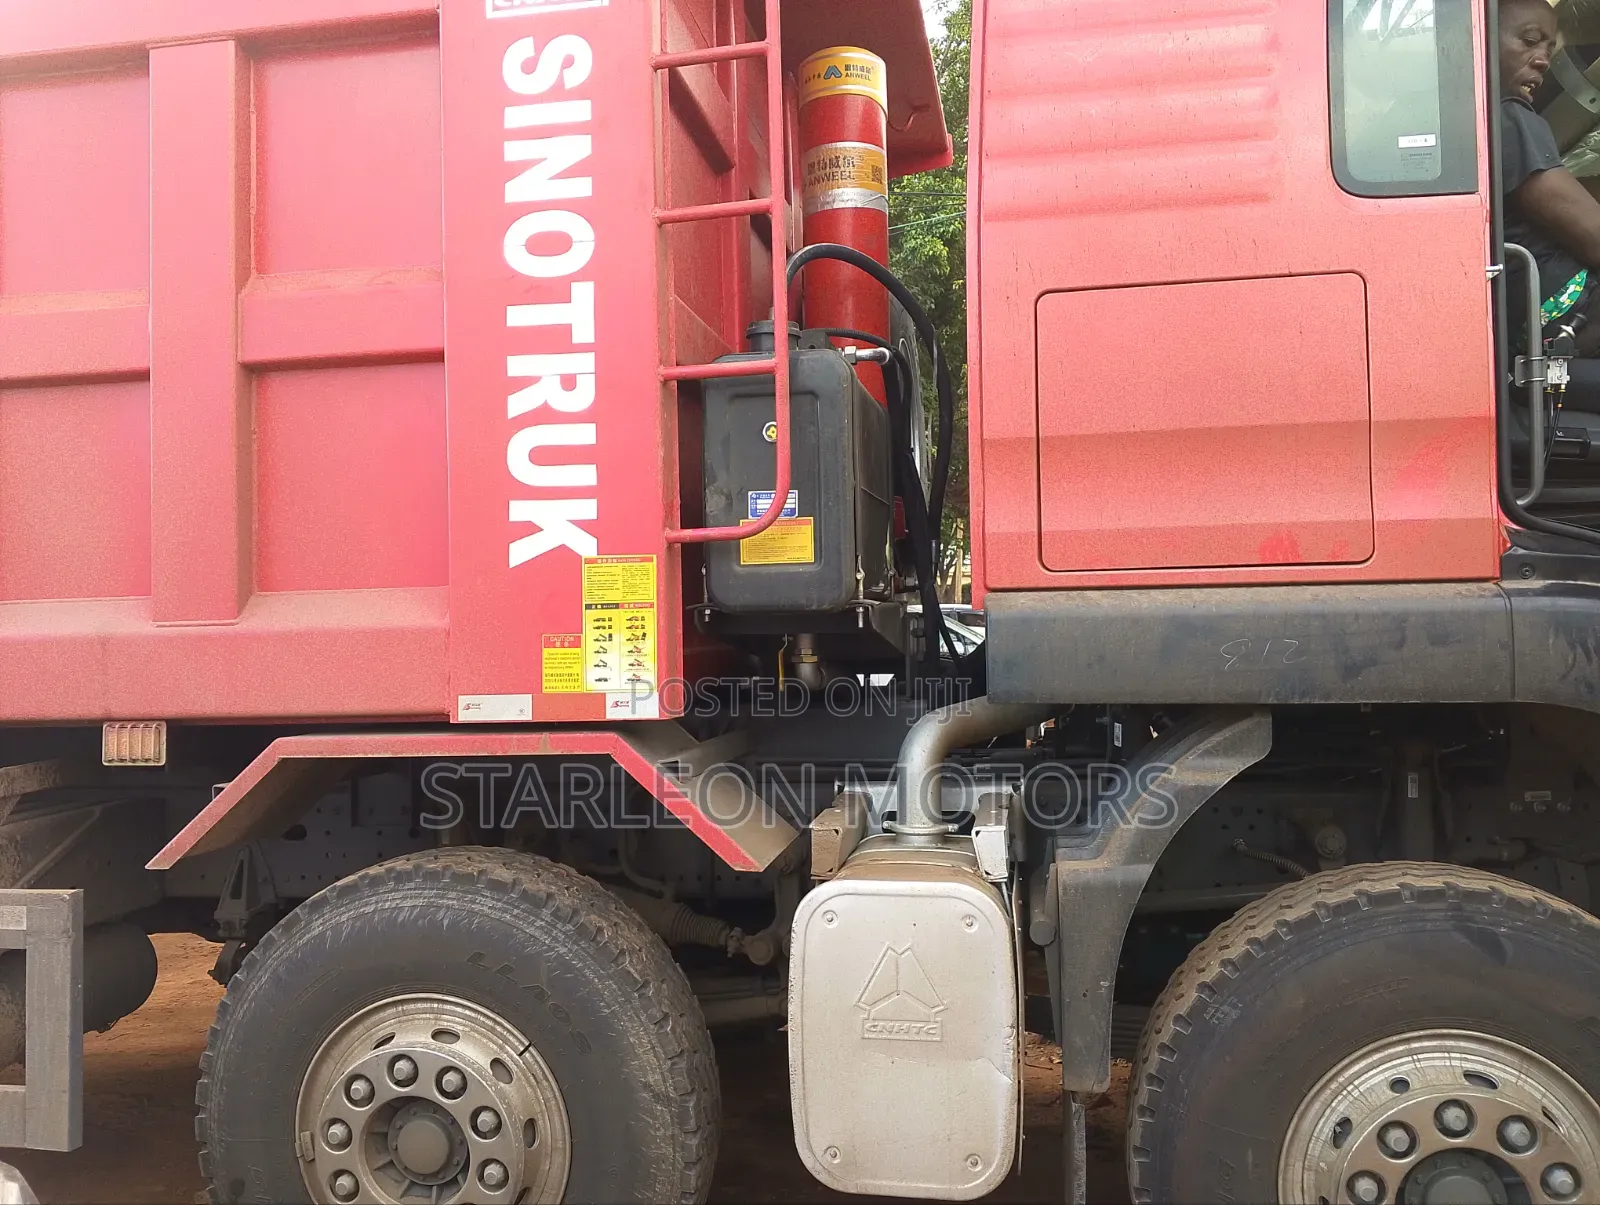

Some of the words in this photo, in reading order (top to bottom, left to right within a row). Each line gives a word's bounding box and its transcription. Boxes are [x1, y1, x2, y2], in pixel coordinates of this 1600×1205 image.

[844, 71, 872, 82] ANWEEL
[808, 170, 856, 188] ANWEEL
[502, 34, 598, 568] SINOTRUK
[864, 1021, 938, 1036] CNHTC
